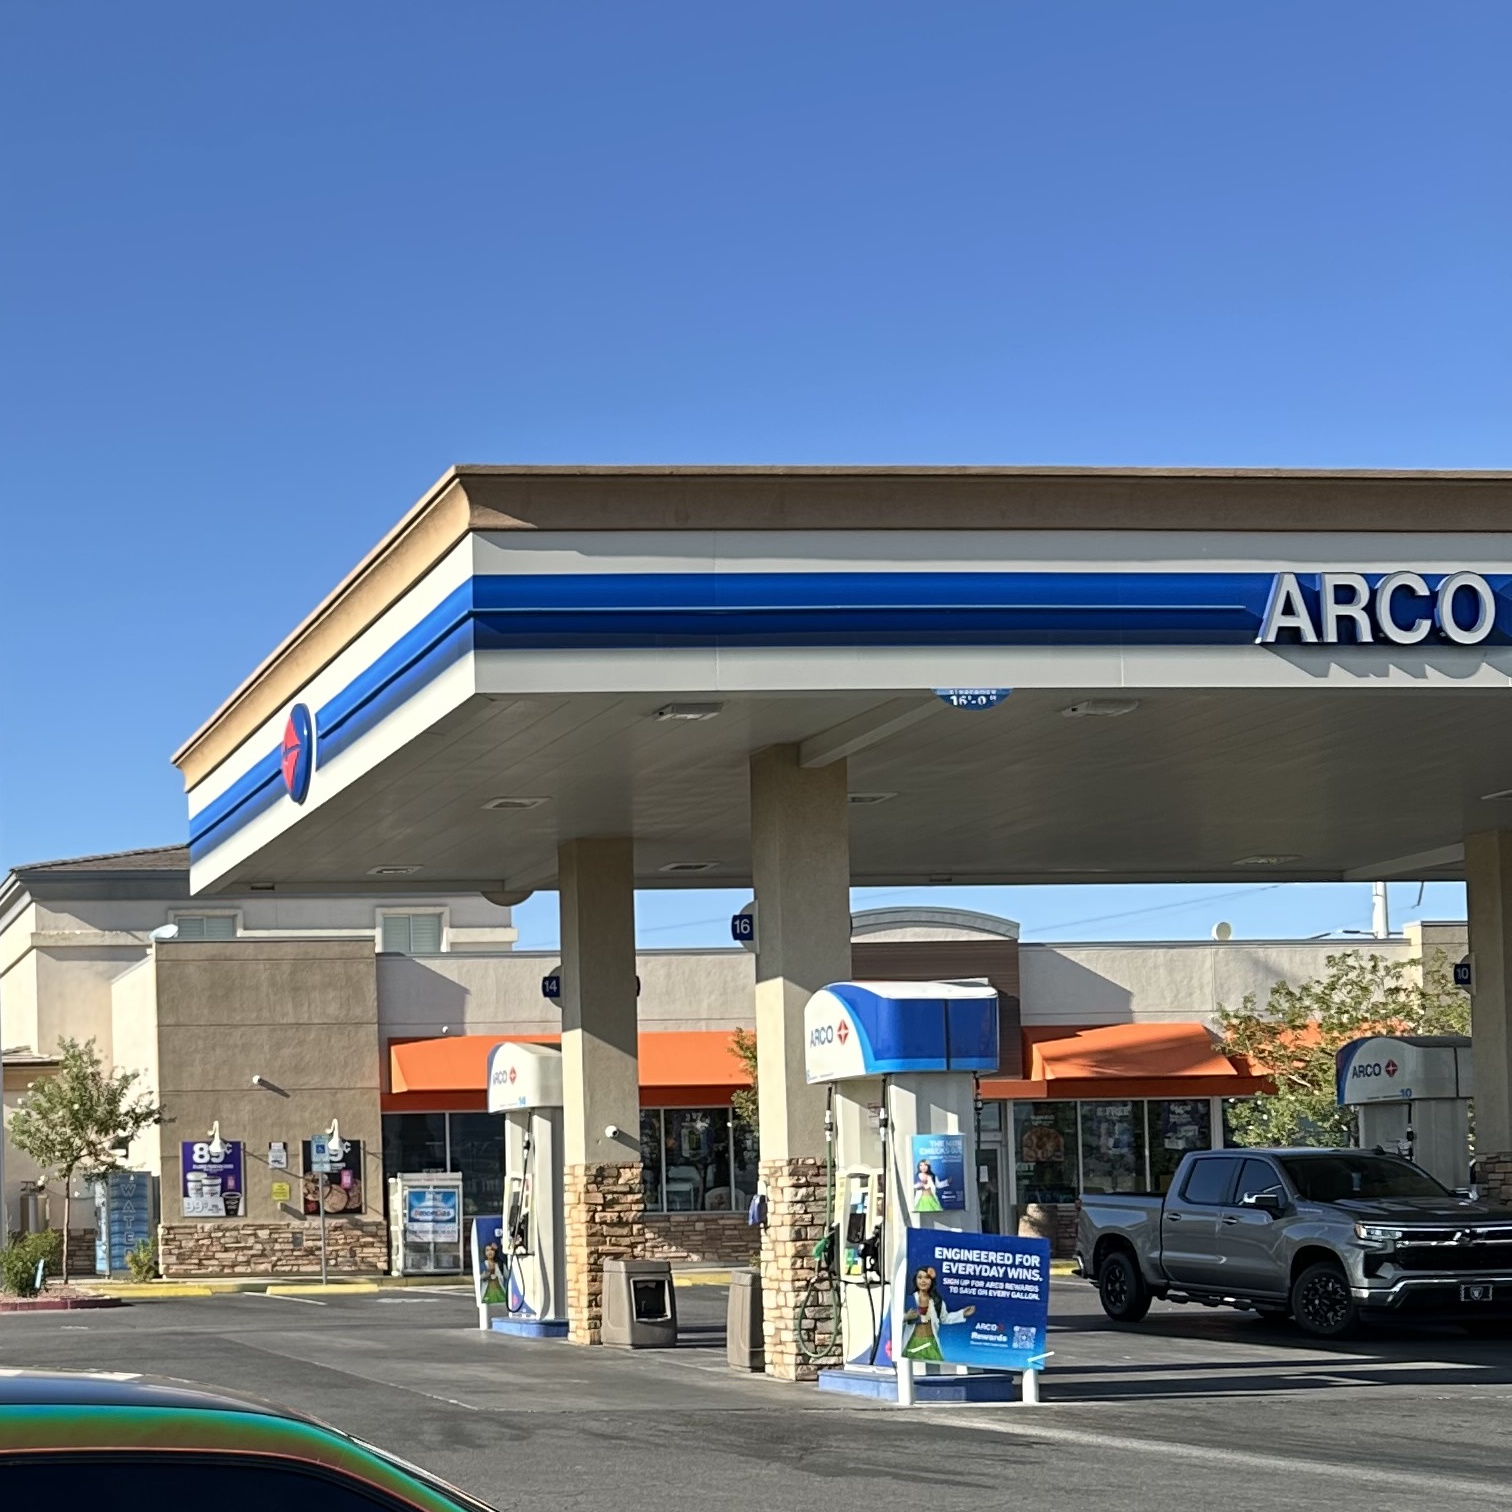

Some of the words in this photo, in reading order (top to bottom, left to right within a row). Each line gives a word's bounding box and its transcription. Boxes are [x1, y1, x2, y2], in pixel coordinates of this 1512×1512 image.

[1256, 571, 1496, 645] ARCO
[734, 918, 751, 934] 16
[1456, 967, 1469, 980] 10
[544, 979, 558, 993] 14
[809, 1025, 834, 1048] ARCO
[1351, 1063, 1382, 1079] ARCO
[934, 1247, 1013, 1265] ENGINEERED
[1015, 1254, 1041, 1267] FOR
[942, 1261, 1006, 1278] EVERYDAY
[1007, 1267, 1044, 1282] WINS.
[942, 1277, 960, 1286] SIGN
[960, 1279, 970, 1287] UP
[971, 1280, 985, 1288] FOR
[985, 1281, 1005, 1290] ARCO
[1005, 1282, 1040, 1293] REWARDS
[949, 1286, 959, 1294] TO
[959, 1287, 977, 1296] SAVE
[988, 1289, 1011, 1298] EVERY
[975, 1322, 998, 1331] ARCO
[971, 1331, 1008, 1342] Rewards
